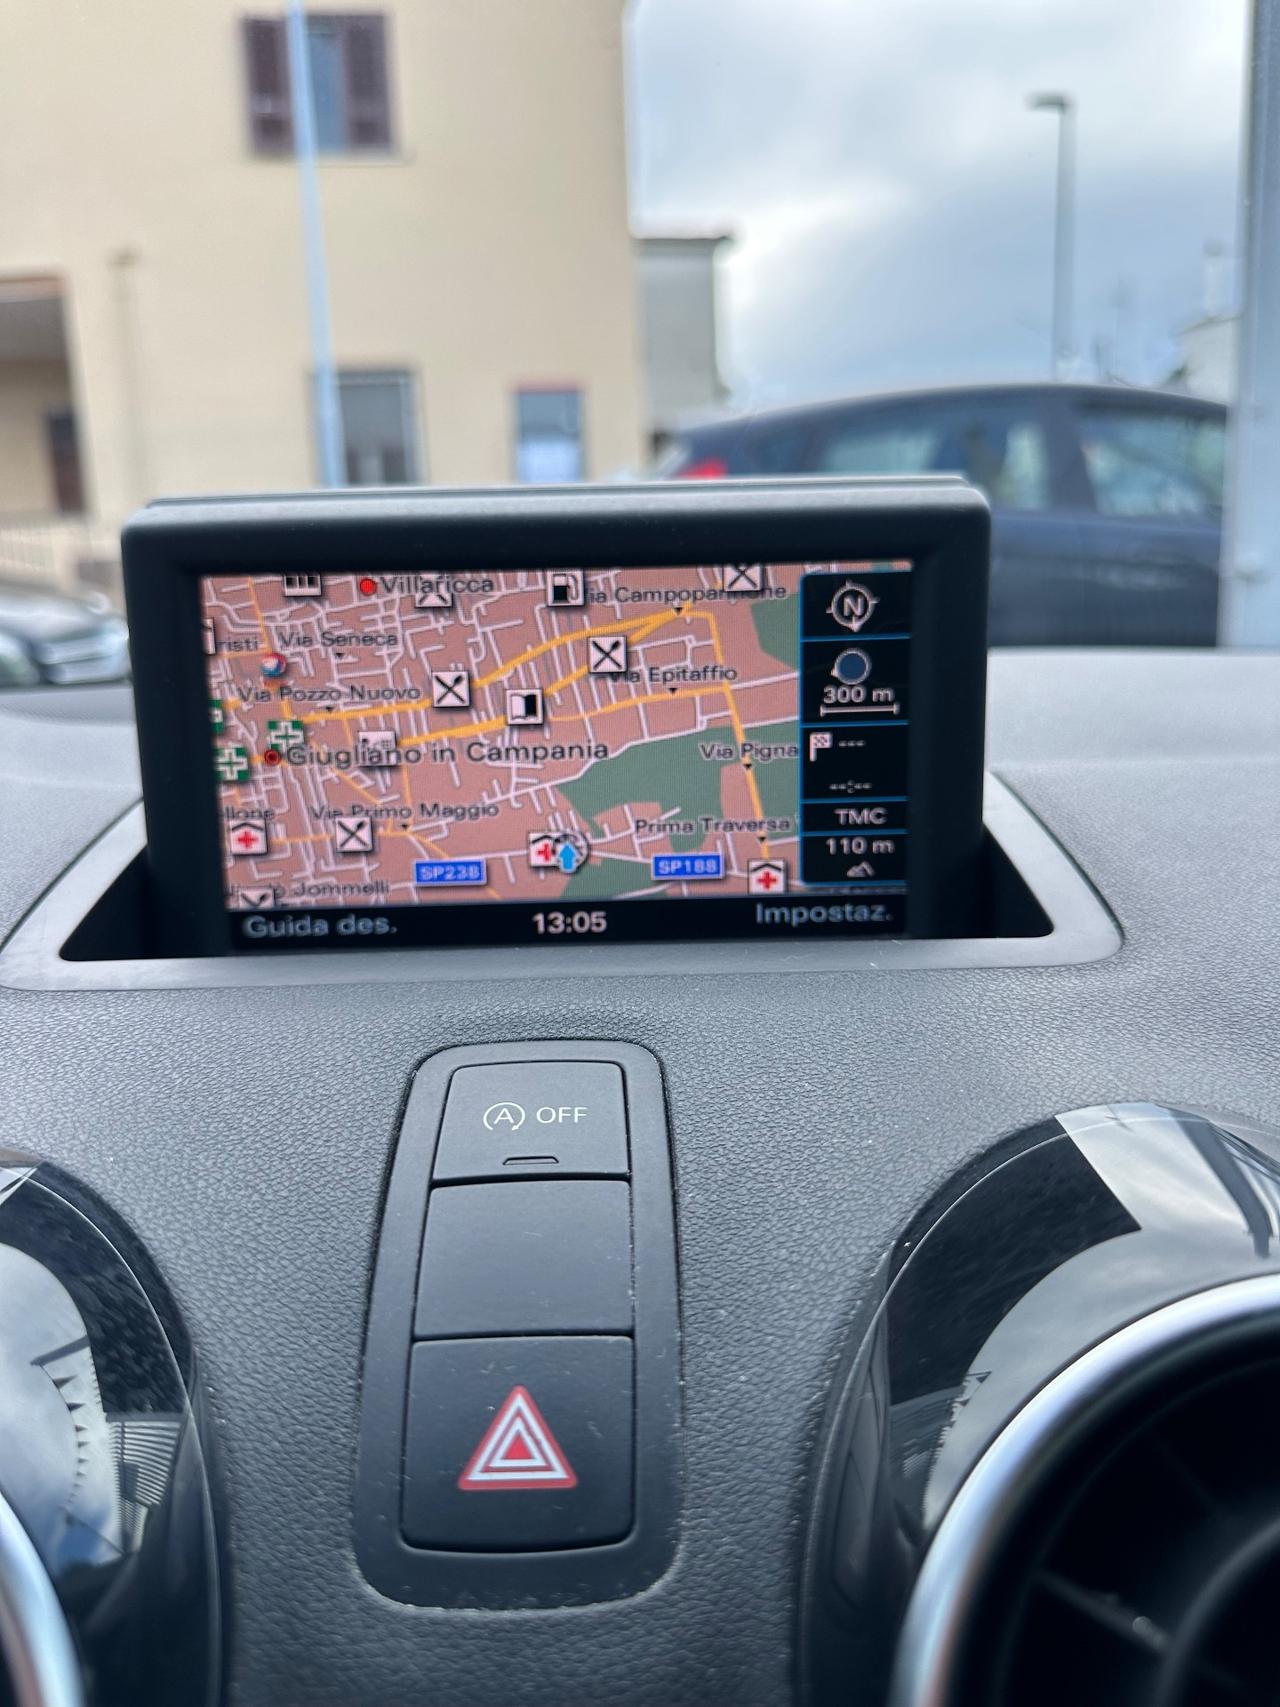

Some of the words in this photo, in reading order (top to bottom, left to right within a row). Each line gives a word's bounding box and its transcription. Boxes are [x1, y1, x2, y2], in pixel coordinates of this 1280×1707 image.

[381, 576, 494, 594] Villaricca
[588, 588, 607, 603] ia
[279, 632, 313, 648] Via
[321, 631, 398, 647] Seneca
[649, 665, 737, 684] Epitaffio
[239, 686, 272, 701] Via
[280, 685, 341, 701] Pozzo
[350, 684, 421, 699] Nuovo
[823, 686, 866, 703] 300
[872, 688, 894, 702] m
[286, 743, 422, 769] Giugliano
[433, 743, 455, 762] in
[467, 739, 609, 763] Campania
[701, 744, 735, 760] Via
[311, 806, 342, 820] Via
[351, 804, 412, 819] Primo
[420, 803, 499, 820] Maggio
[834, 808, 887, 825] TMC
[635, 818, 694, 834] Prima
[702, 817, 790, 832] Traversa
[826, 837, 868, 855] 110
[872, 839, 895, 854] m
[532, 911, 607, 934] 13:05
[755, 902, 894, 928] Impostaz.
[242, 915, 329, 939] Guida
[336, 913, 398, 936] des.
[536, 1106, 588, 1124] OFF
